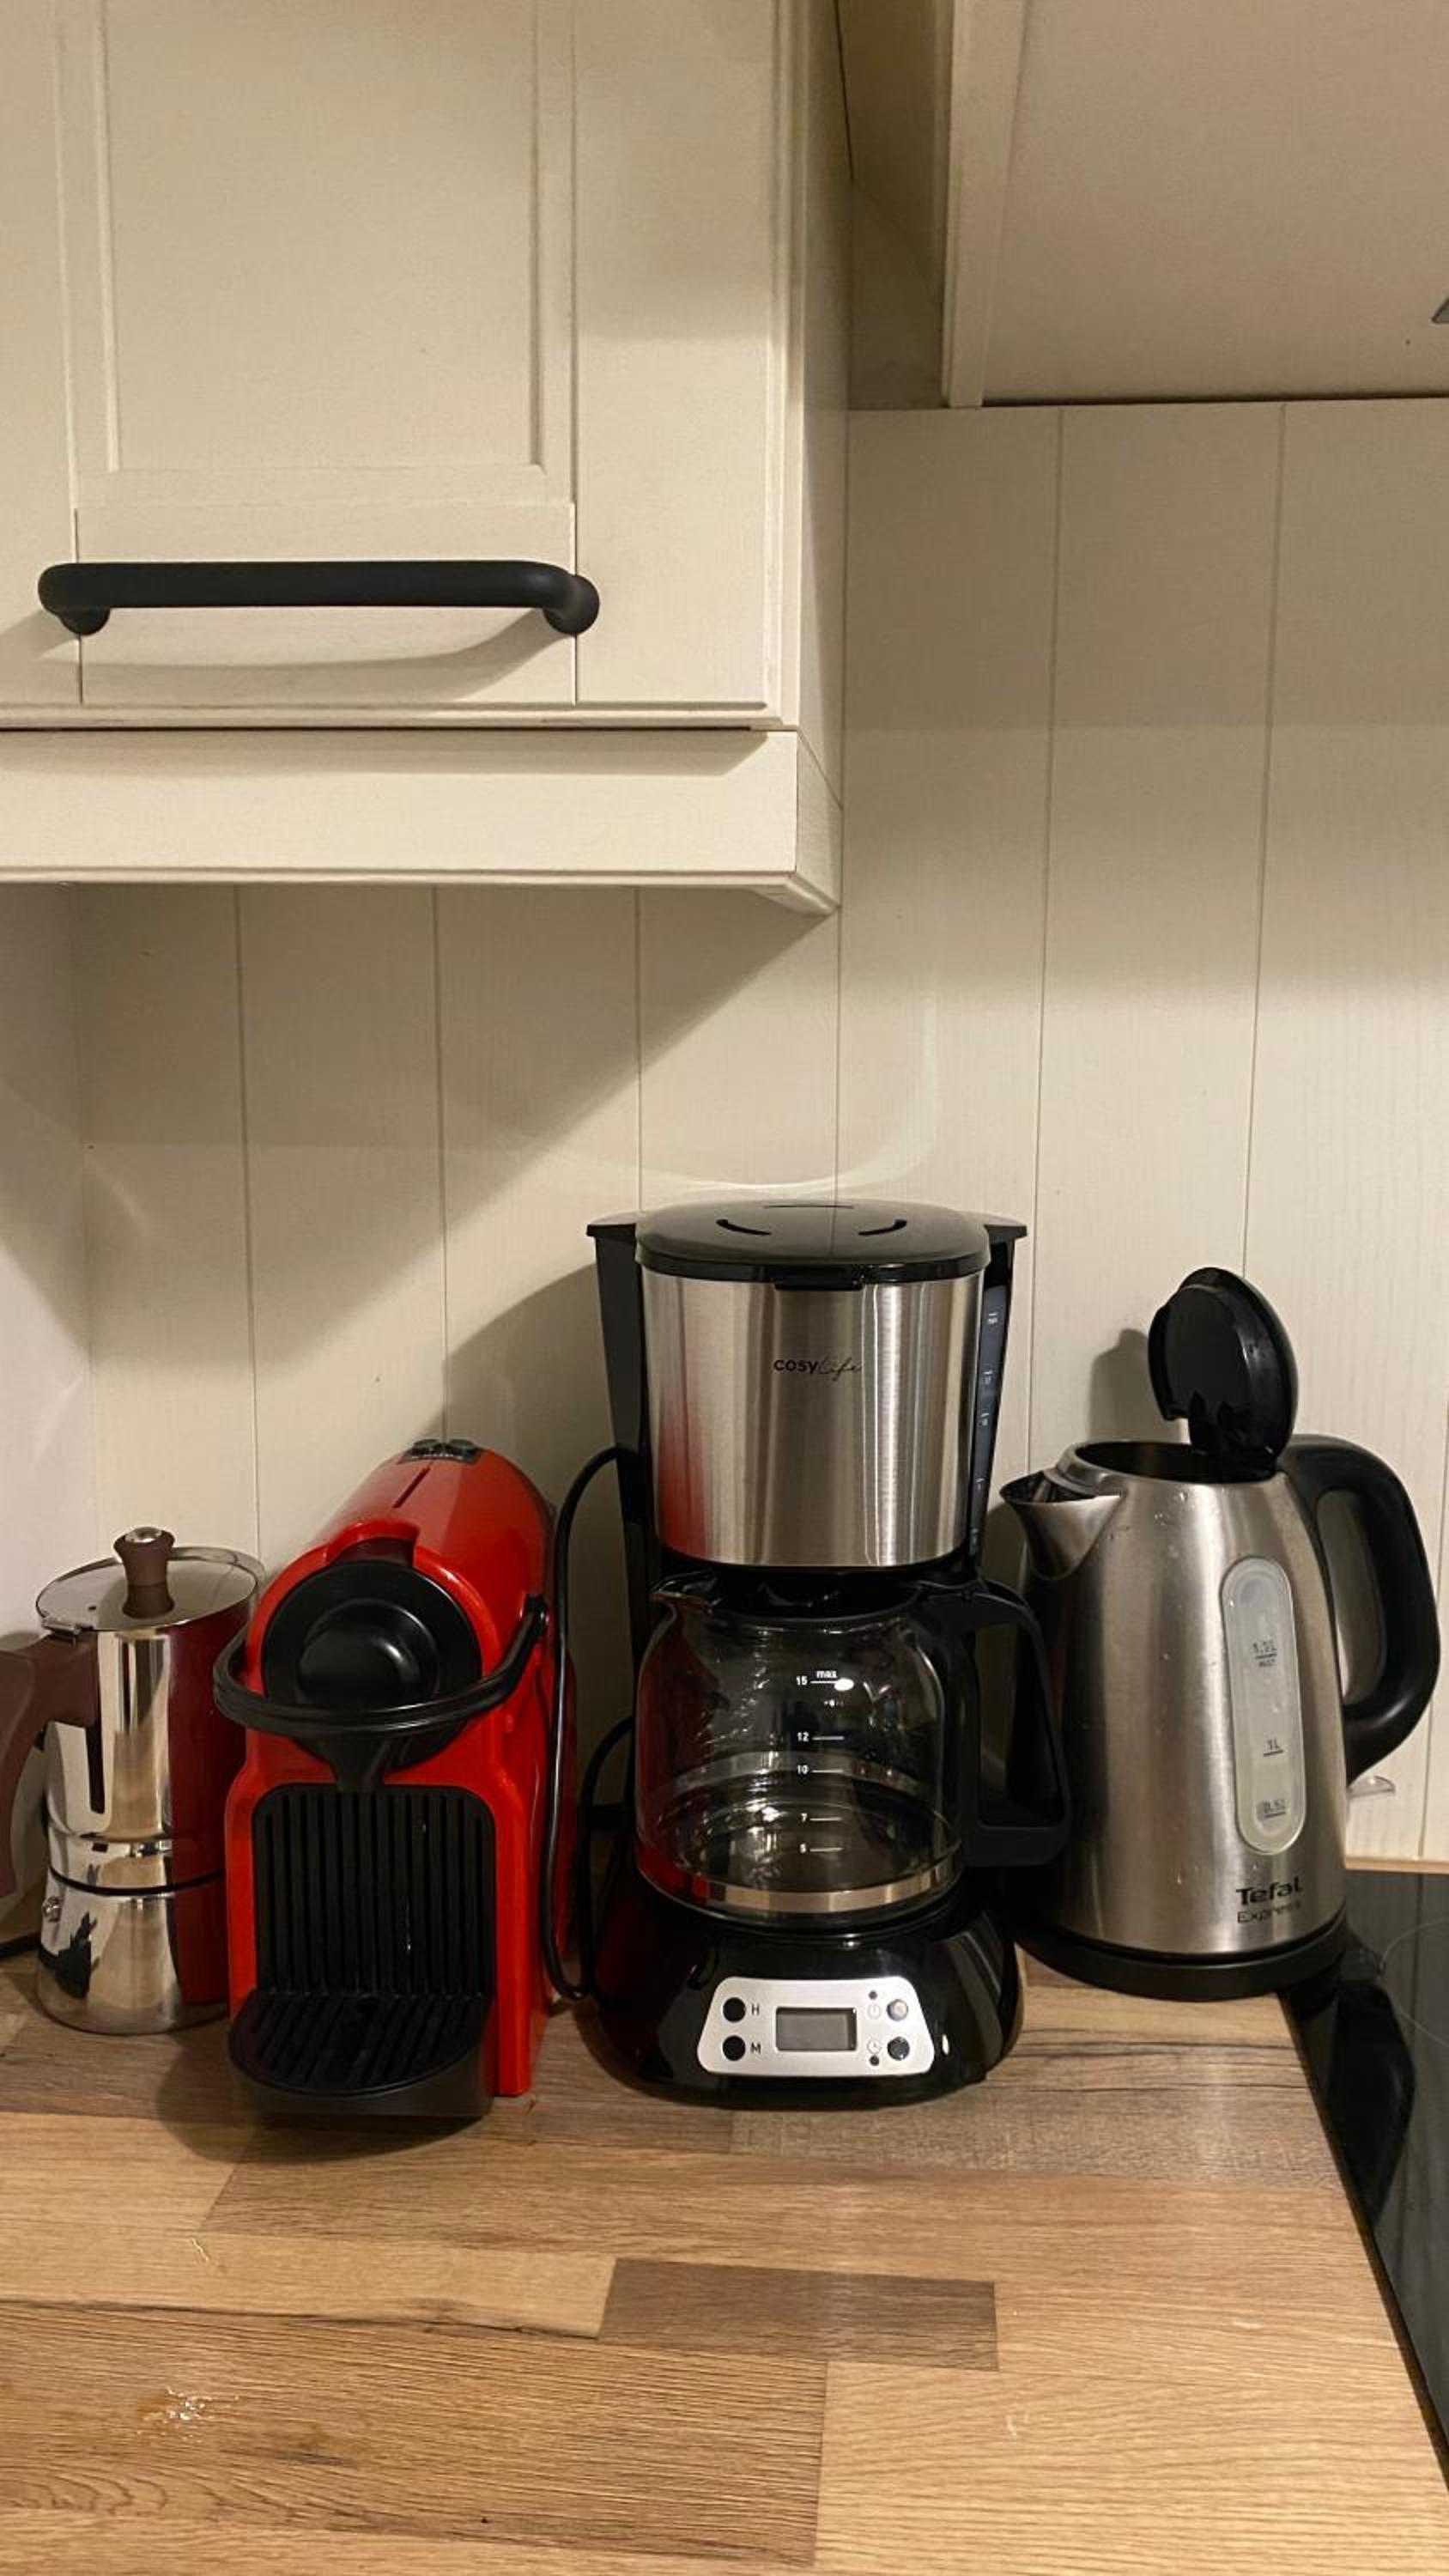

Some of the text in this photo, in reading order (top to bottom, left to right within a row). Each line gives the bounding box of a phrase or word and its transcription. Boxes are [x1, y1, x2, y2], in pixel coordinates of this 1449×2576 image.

[816, 1669, 837, 1679] max
[796, 1676, 808, 1686] 15
[797, 1732, 809, 1741] 12
[797, 1765, 809, 1774] 10
[801, 1814, 808, 1822] 7
[1236, 1877, 1303, 1905] Tefal
[751, 2004, 760, 2015] H
[750, 2043, 761, 2053] M
